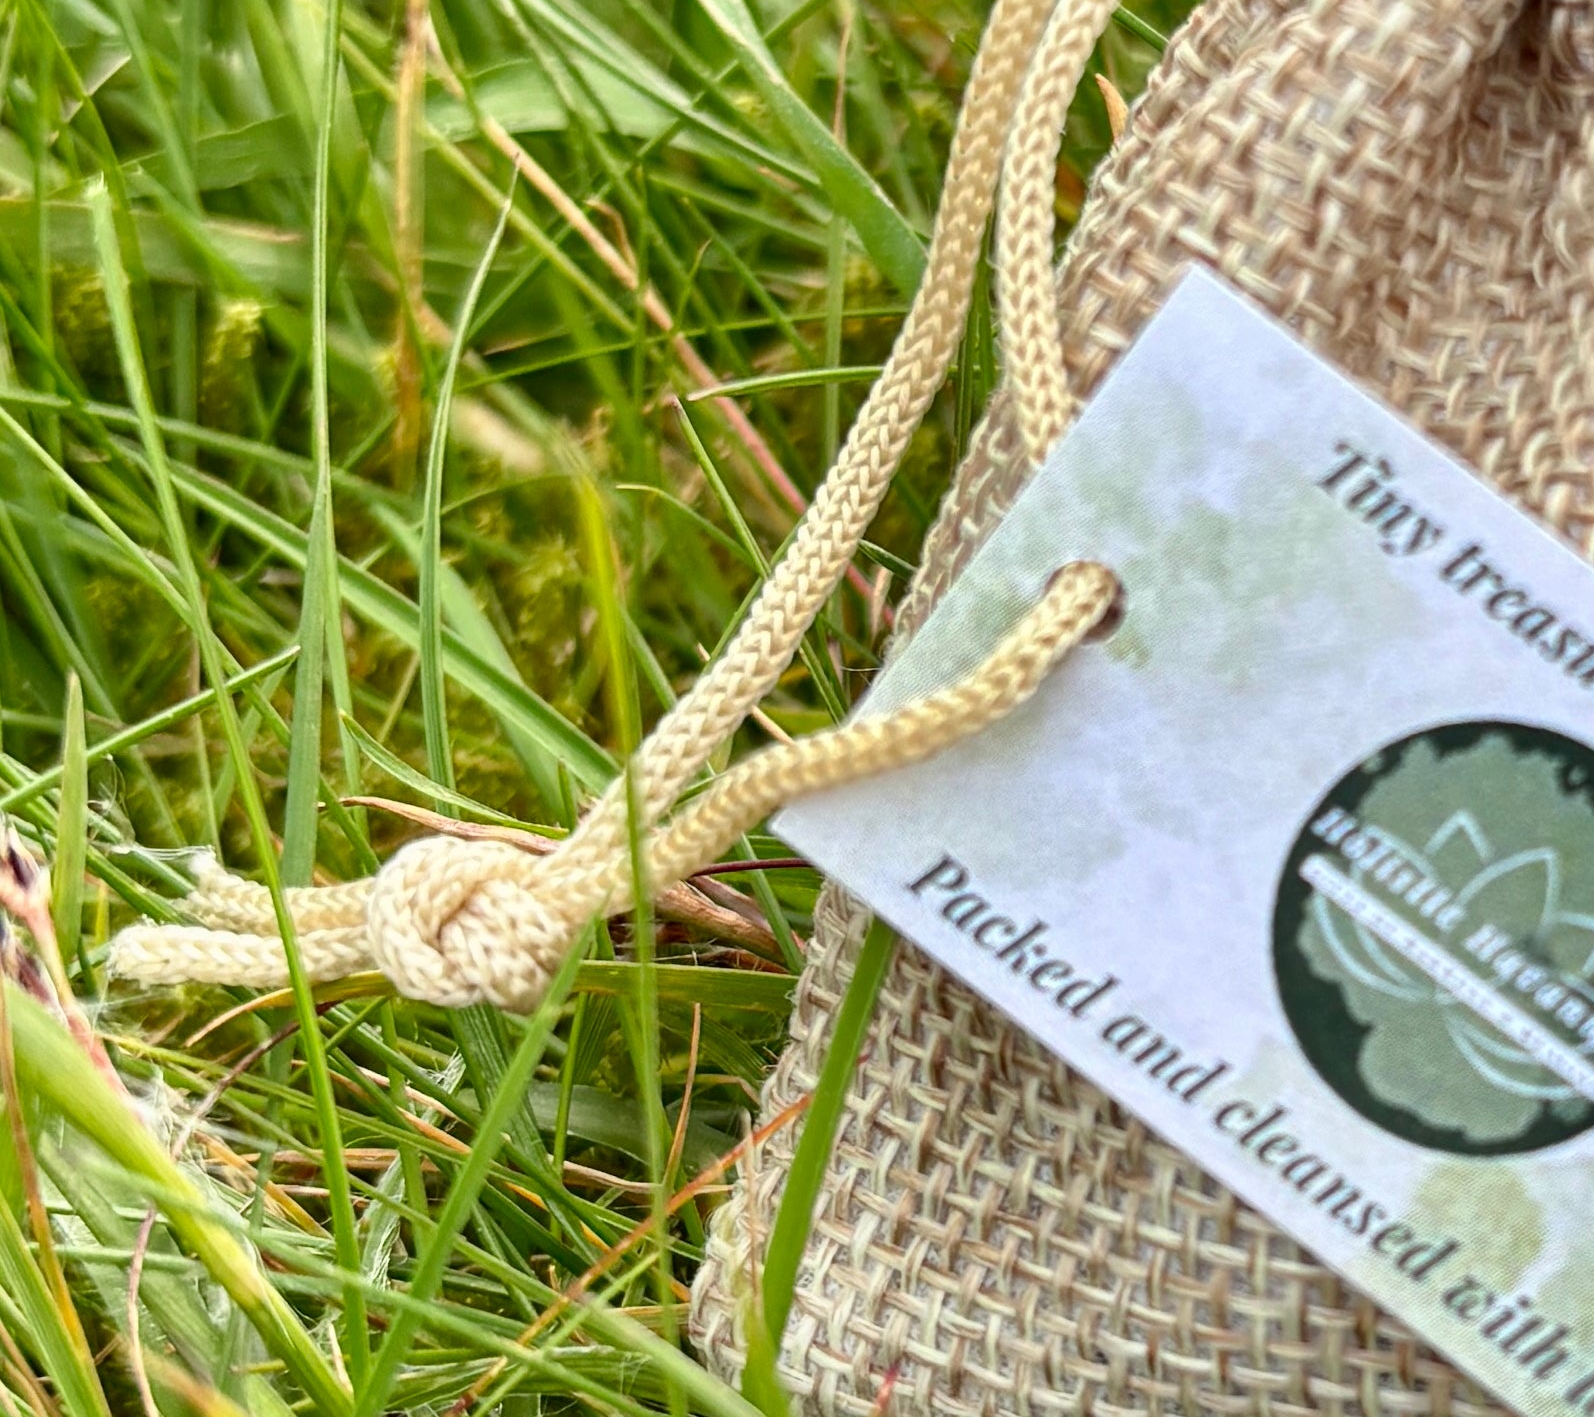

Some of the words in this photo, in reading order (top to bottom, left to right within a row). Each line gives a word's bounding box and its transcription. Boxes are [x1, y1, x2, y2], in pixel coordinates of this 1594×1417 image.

[1318, 438, 1445, 557] Tiny
[907, 854, 1119, 1016] Packed
[1101, 1014, 1230, 1103] and
[1213, 1097, 1459, 1283] cleansed
[1440, 1274, 1570, 1382] with
